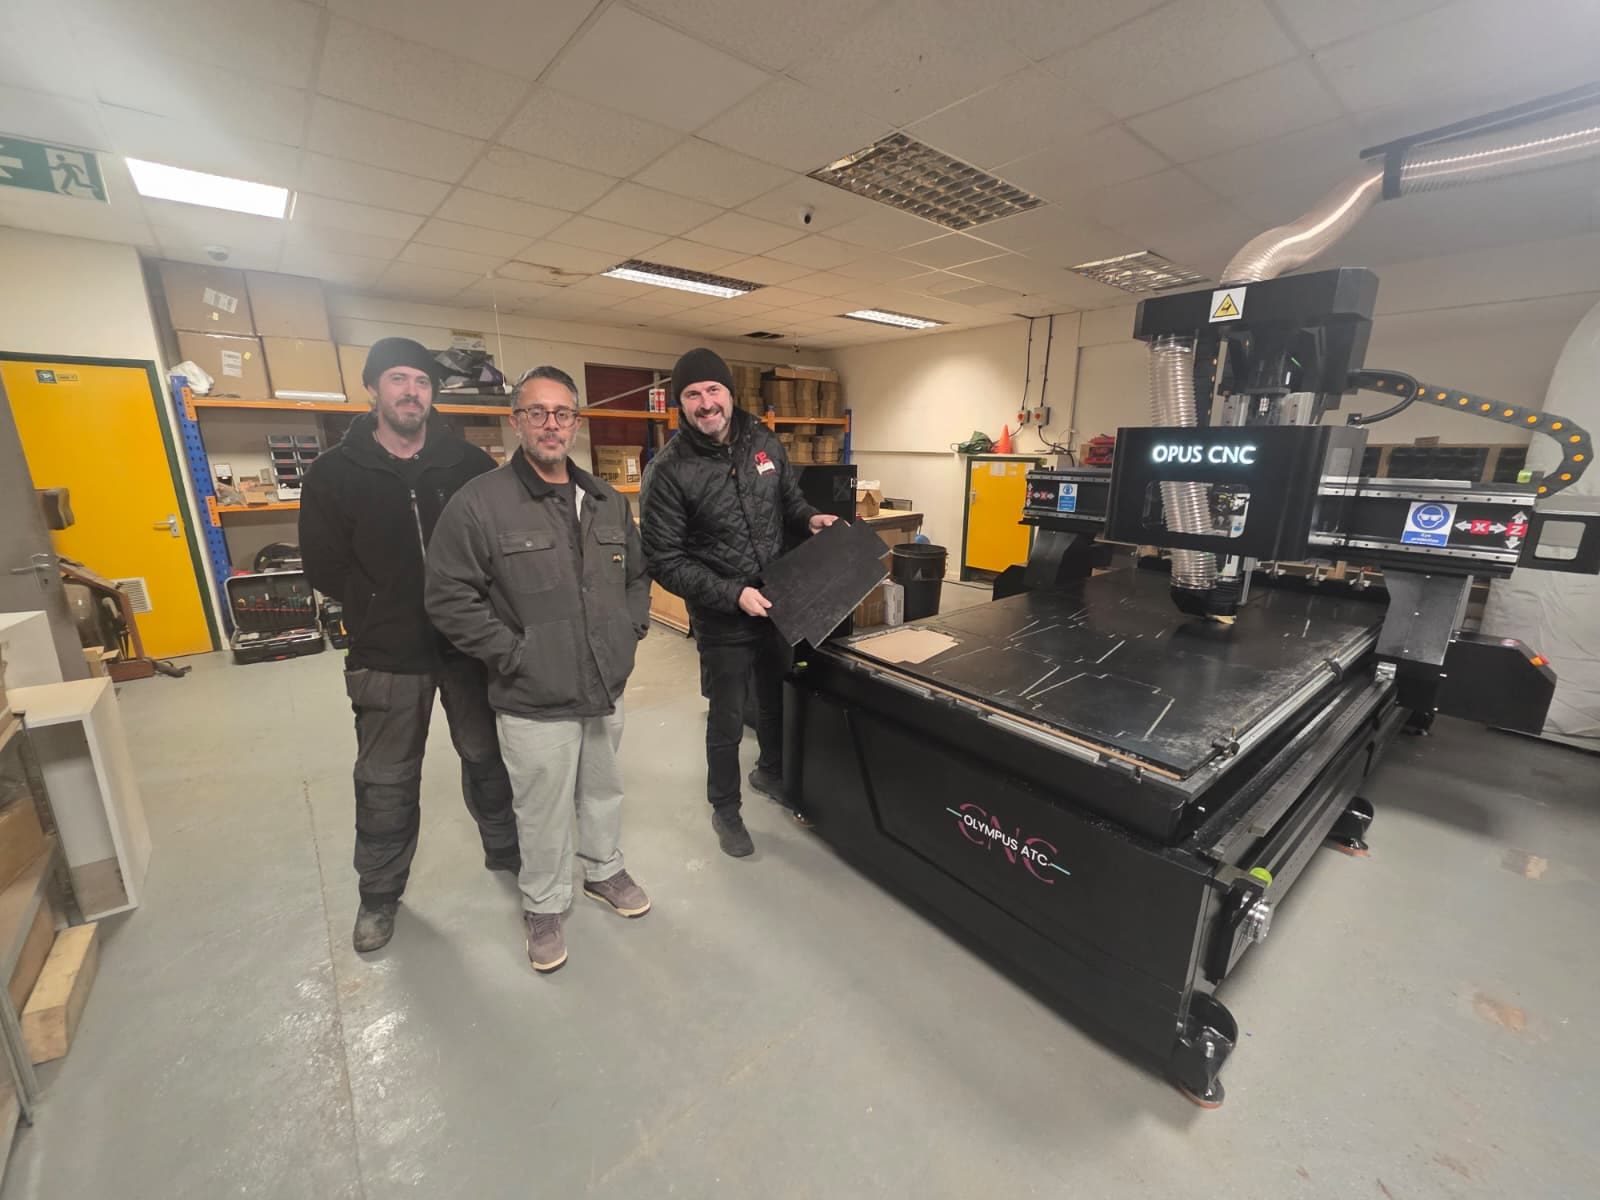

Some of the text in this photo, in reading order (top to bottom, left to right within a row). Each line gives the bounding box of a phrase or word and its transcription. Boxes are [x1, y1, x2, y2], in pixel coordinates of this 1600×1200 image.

[1152, 444, 1257, 464] OPUS CNC
[1475, 522, 1486, 532] X
[1510, 525, 1522, 535] Z
[963, 814, 1048, 866] OLYMPUS ATC
